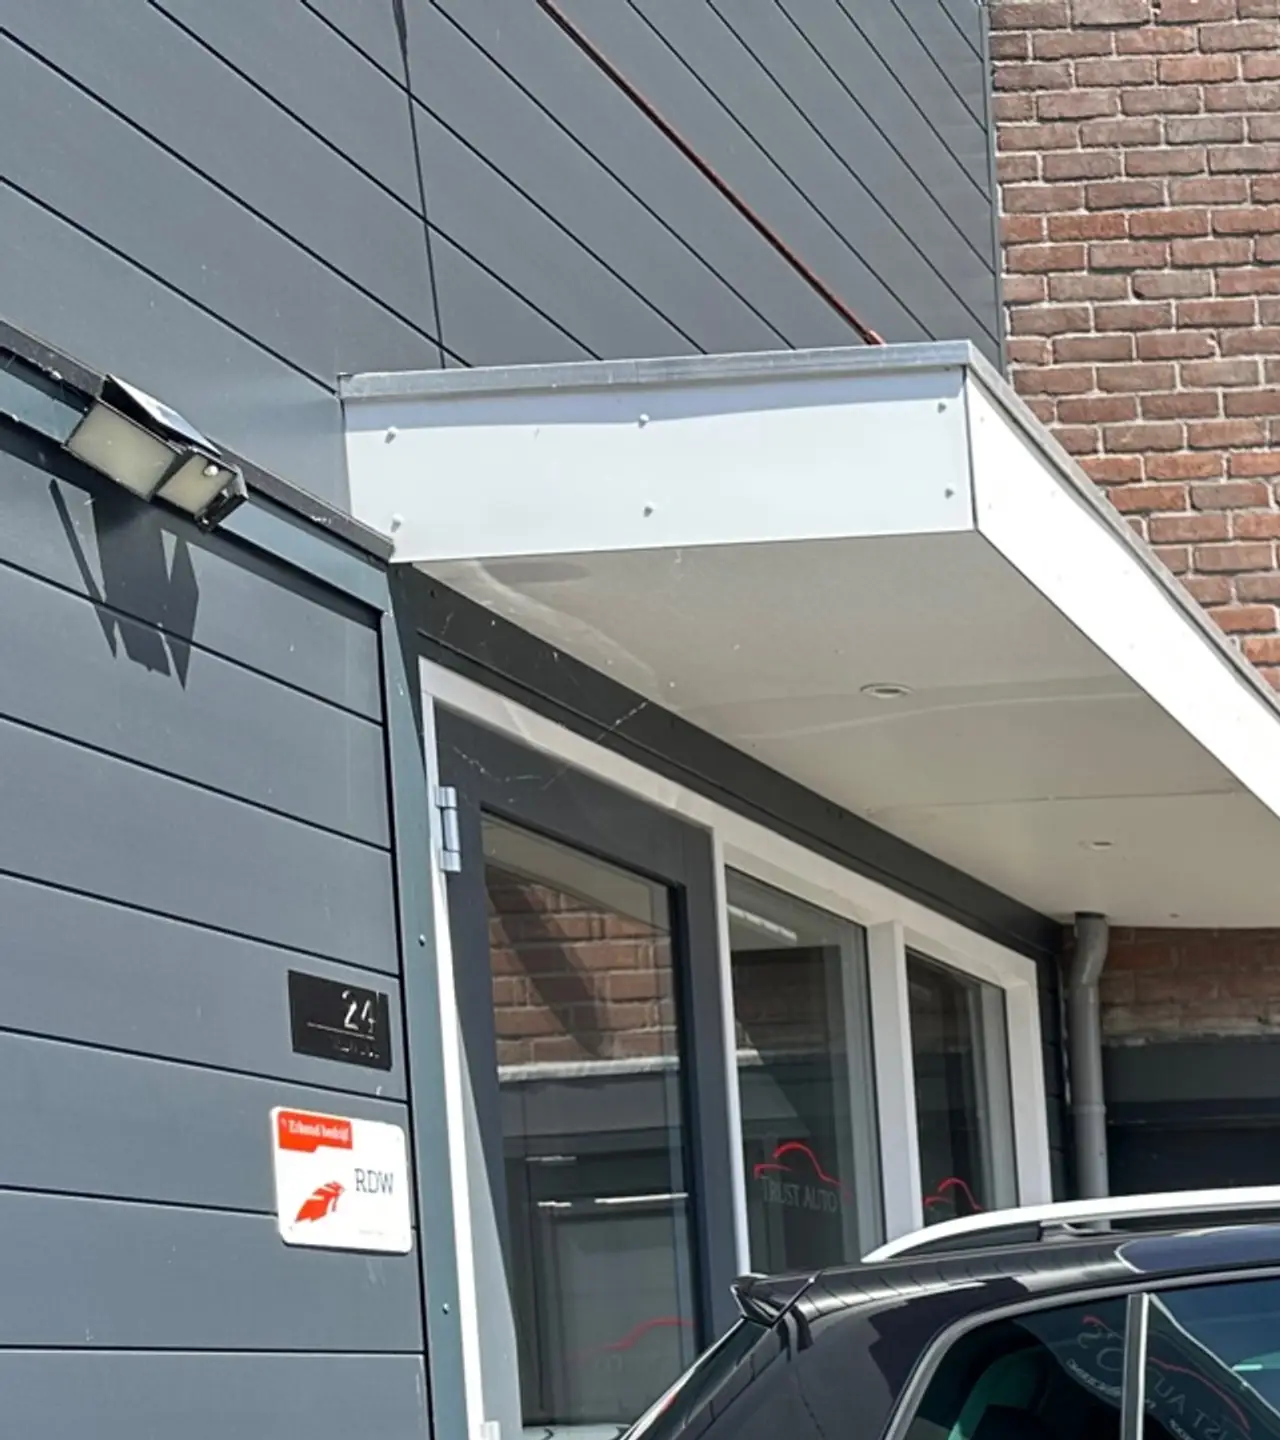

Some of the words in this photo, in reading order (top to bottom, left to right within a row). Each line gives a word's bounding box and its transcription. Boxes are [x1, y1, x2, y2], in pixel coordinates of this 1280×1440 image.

[341, 989, 376, 1034] 24
[354, 1168, 394, 1195] RDW
[761, 1175, 799, 1207] TRUST
